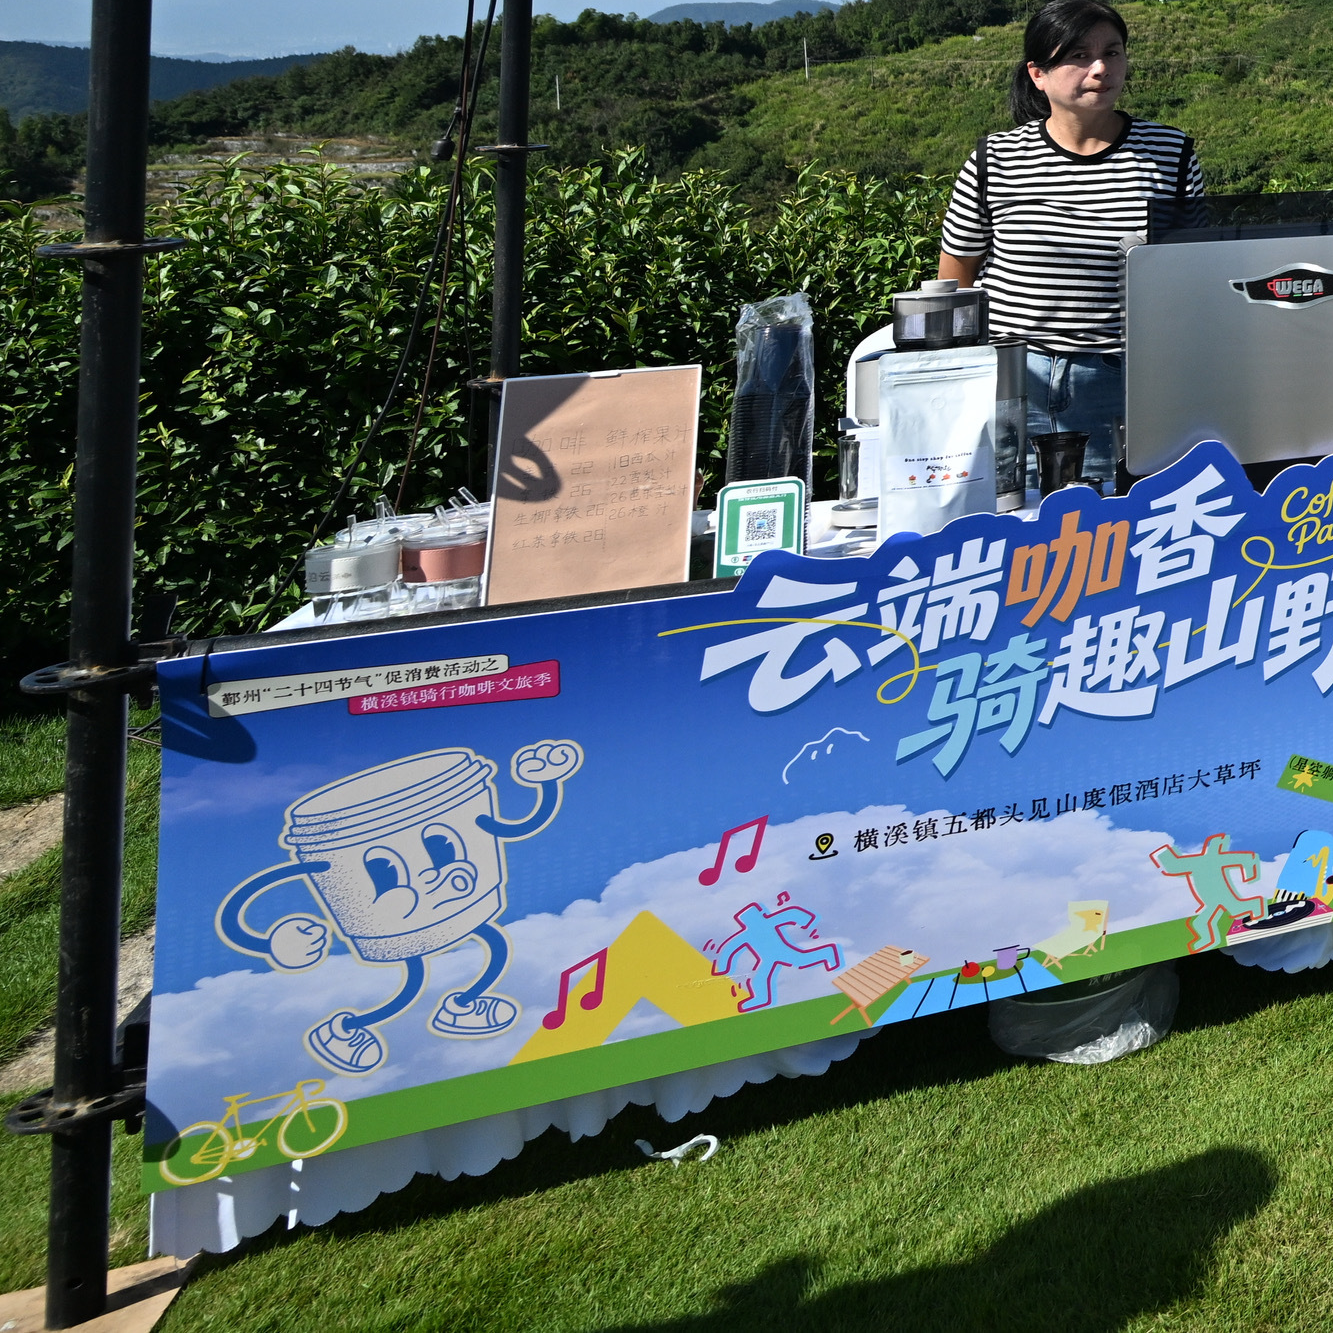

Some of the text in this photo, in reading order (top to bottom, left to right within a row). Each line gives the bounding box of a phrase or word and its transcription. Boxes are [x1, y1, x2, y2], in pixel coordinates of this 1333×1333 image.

[1275, 277, 1324, 295] WEGA
[571, 461, 594, 475] 22
[570, 484, 592, 498] 26
[586, 503, 605, 517] 26
[700, 464, 1247, 712] 云端咖香
[222, 657, 499, 707] 鄞州“二十四节气”促消费活动之
[360, 671, 552, 712] 横溪镇骑行咖啡文旅季
[853, 758, 1262, 854] 横溪镇五都头见山度假酒店大草坪
